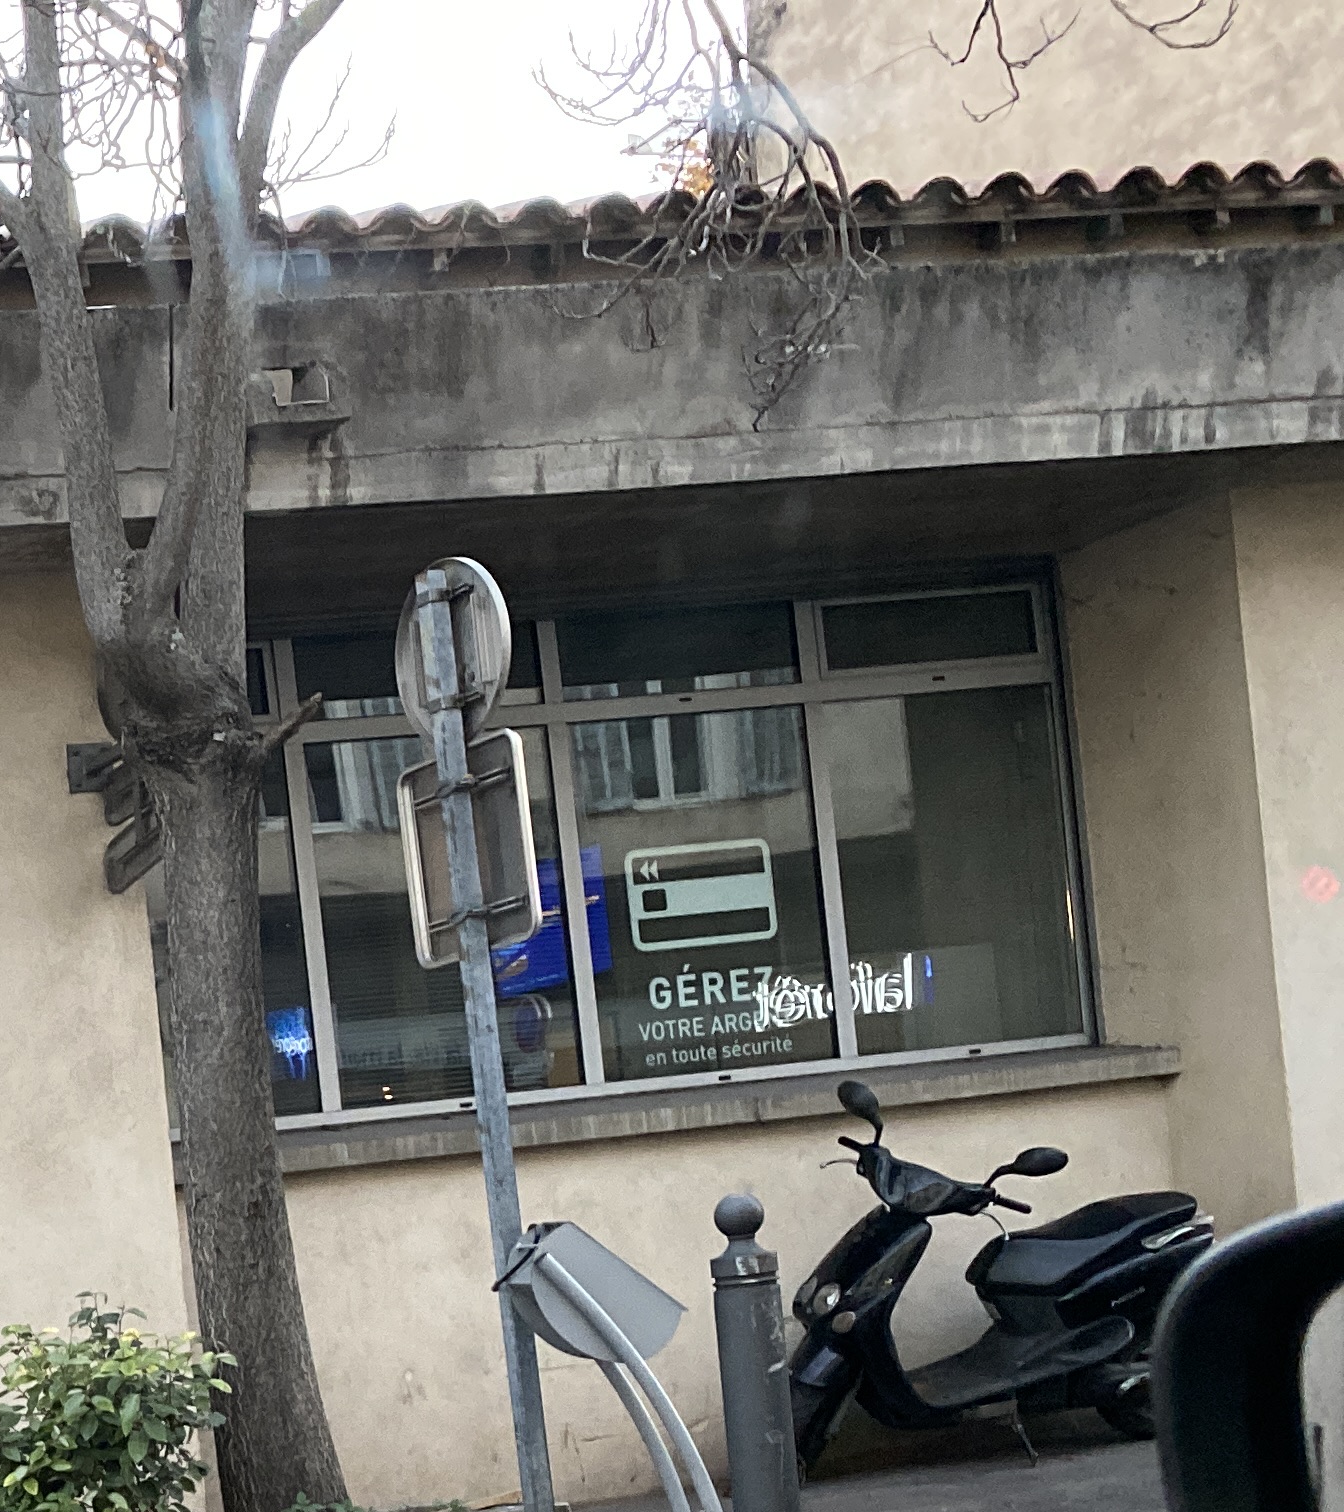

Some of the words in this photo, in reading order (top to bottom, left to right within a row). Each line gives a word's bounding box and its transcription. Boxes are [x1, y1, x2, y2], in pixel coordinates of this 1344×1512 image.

[639, 1015, 706, 1042] VOTRE
[645, 1052, 667, 1067] en
[672, 1045, 717, 1063] toute
[722, 1034, 794, 1057] sécurité
